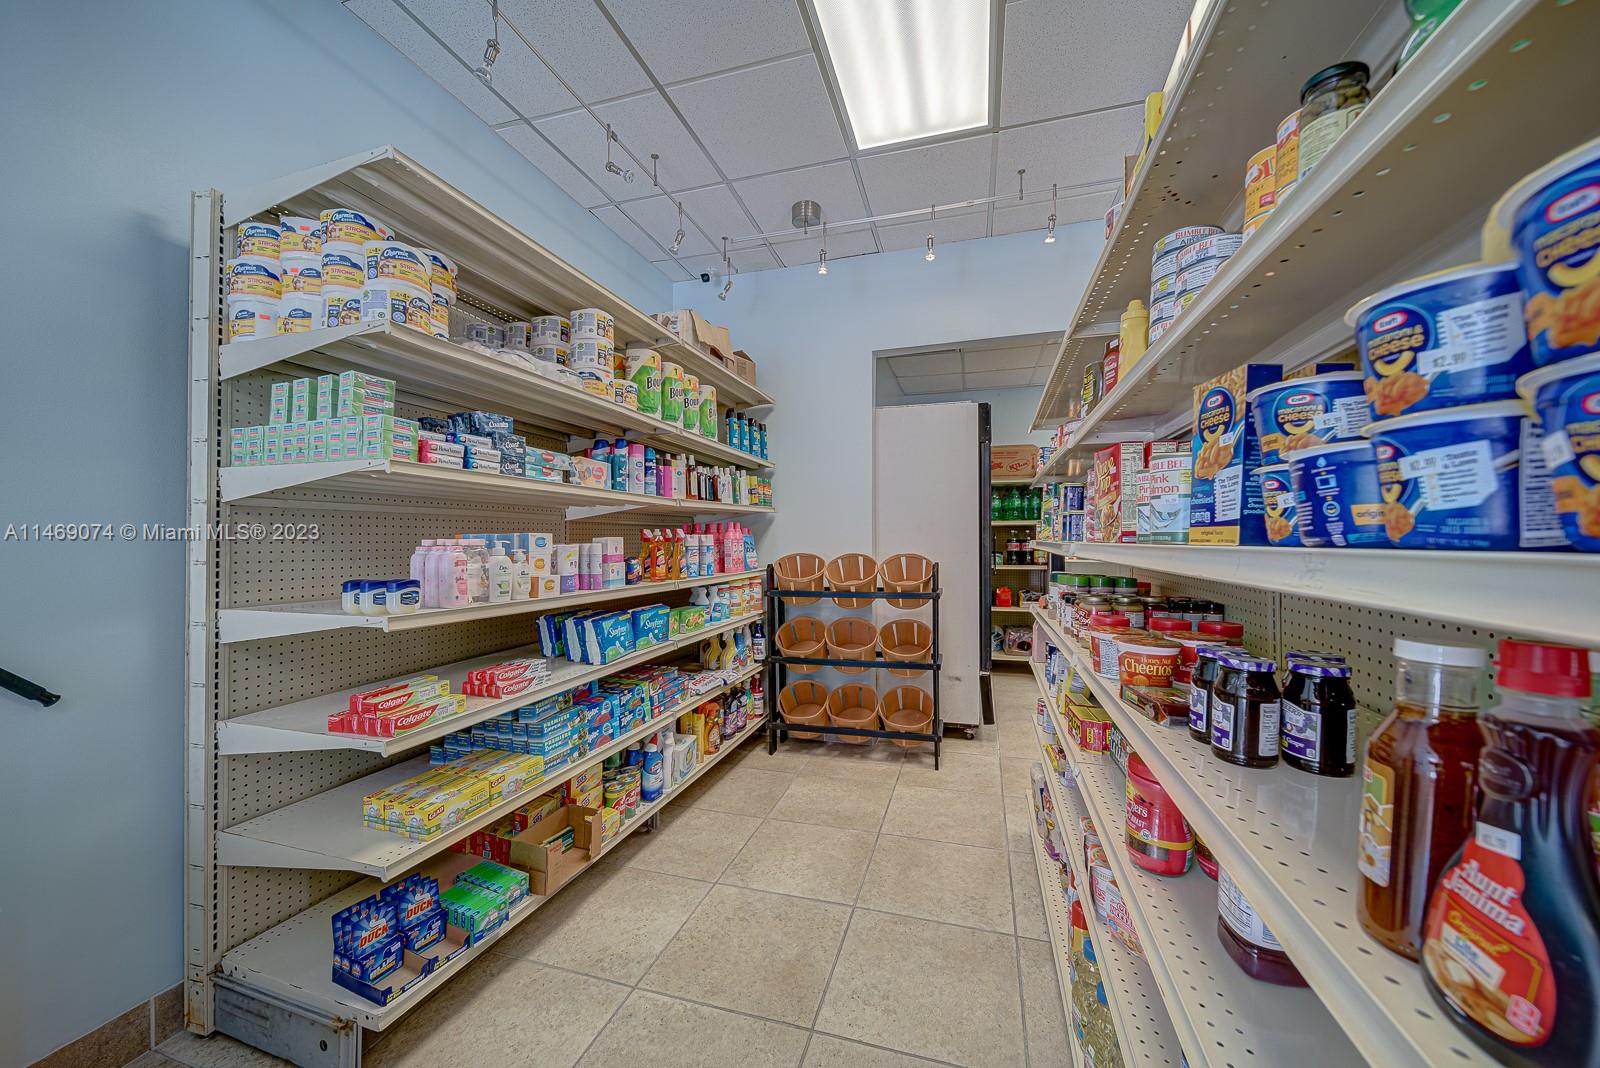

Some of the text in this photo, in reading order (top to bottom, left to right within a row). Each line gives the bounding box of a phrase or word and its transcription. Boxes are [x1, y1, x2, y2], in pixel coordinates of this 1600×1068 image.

[344, 225, 370, 236] STRONG
[330, 268, 355, 277] STRONG
[247, 278, 273, 287] STRONG
[505, 462, 520, 470] Coast
[1167, 459, 1186, 470] BEE
[499, 668, 526, 681] Colgate
[1124, 658, 1174, 677] Cheerios
[503, 681, 529, 694] Colgate
[378, 696, 410, 710] Colgate
[397, 709, 433, 726] Colgate
[429, 807, 445, 821] GLAD
[1462, 859, 1521, 908] Aunt
[406, 898, 433, 920] DUCK
[1442, 868, 1526, 937] Jemima
[359, 924, 389, 949] DUCK
